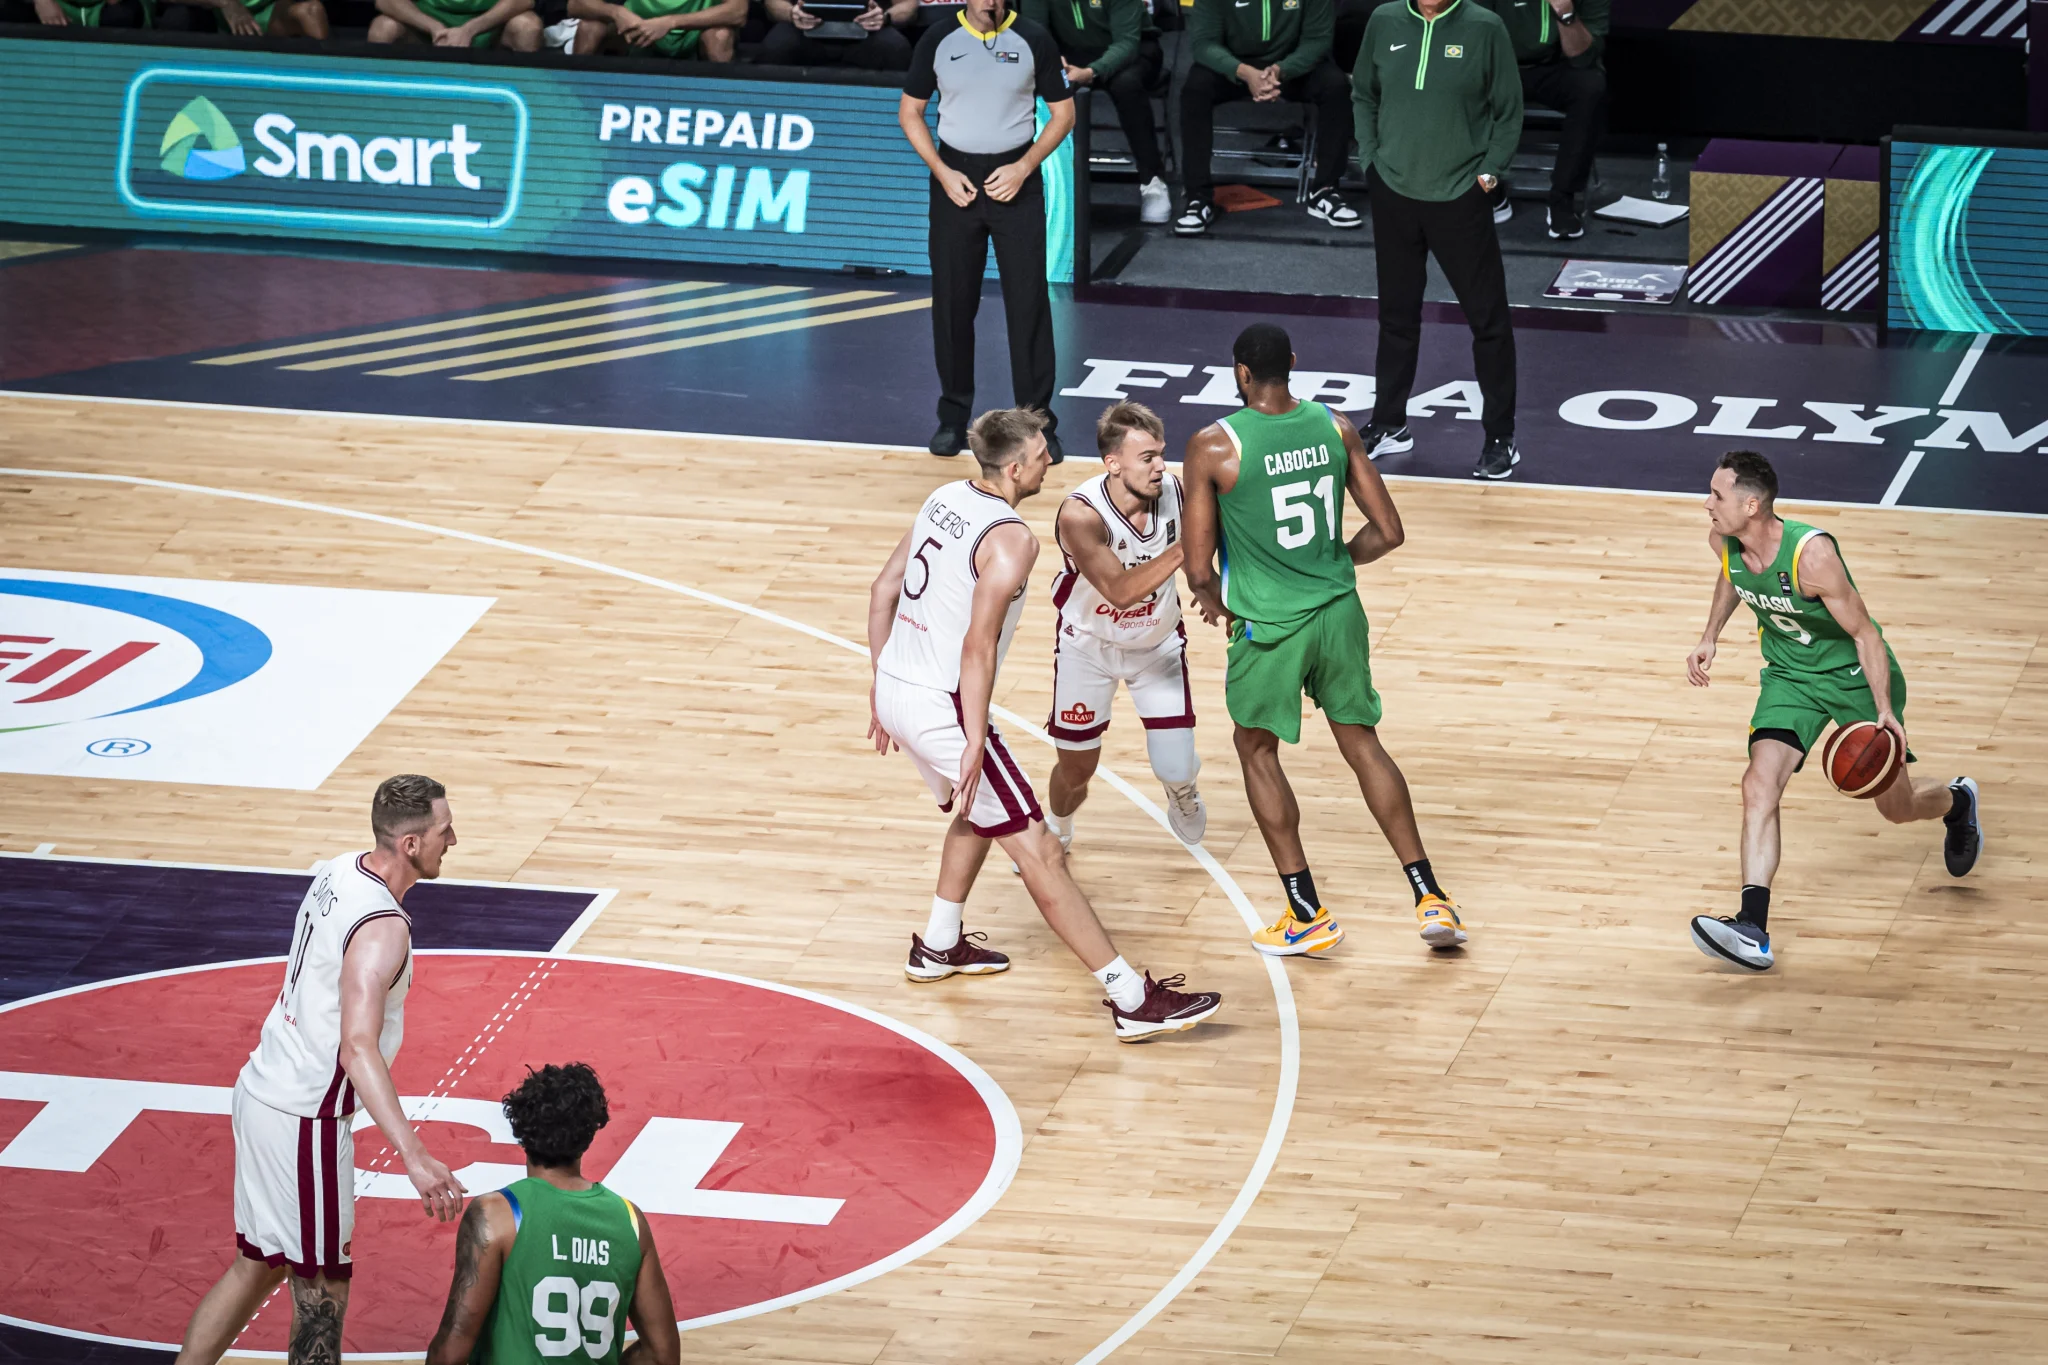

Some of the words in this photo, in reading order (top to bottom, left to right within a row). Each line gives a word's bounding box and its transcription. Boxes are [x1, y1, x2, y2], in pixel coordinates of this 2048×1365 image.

[253, 113, 481, 190] Smart
[599, 104, 815, 151] PREPAID
[608, 162, 810, 233] eSIM
[1264, 444, 1329, 476] CABOCLO
[1271, 475, 1335, 550] 51
[903, 536, 943, 600] 5
[1734, 584, 1803, 614] BRASIL
[0, 1071, 846, 1226] TCL
[552, 1234, 568, 1261] L.
[572, 1237, 610, 1266] DIAS
[532, 1276, 620, 1359] 99
